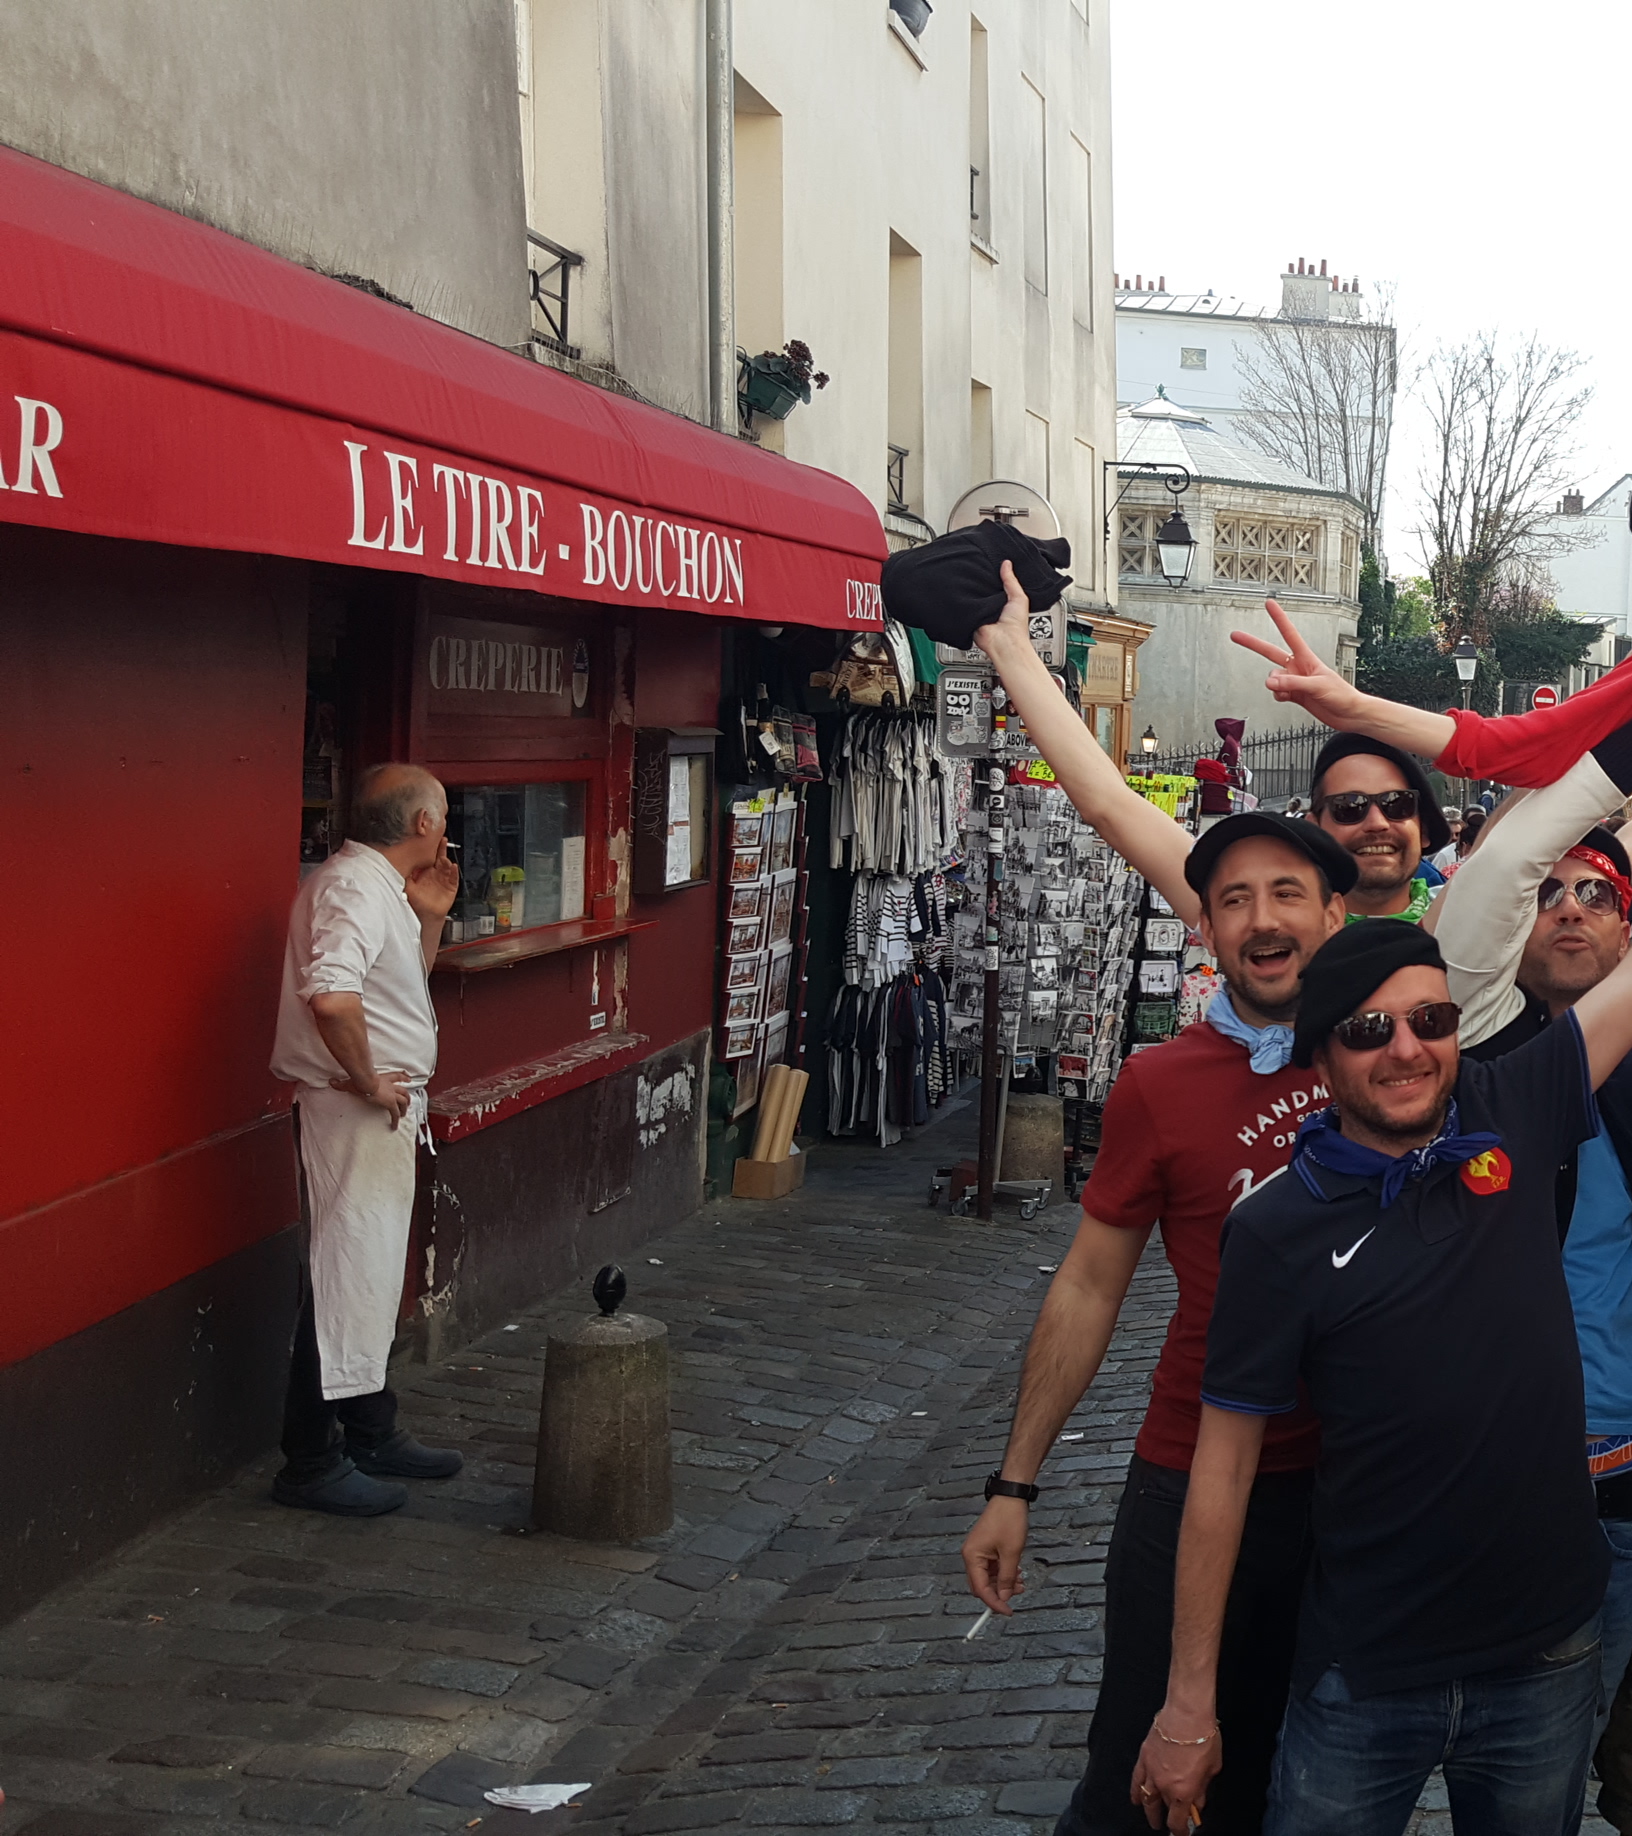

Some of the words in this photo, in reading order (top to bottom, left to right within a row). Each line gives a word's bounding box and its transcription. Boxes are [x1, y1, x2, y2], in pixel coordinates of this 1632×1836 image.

[0, 395, 64, 498] R
[343, 440, 424, 556] LE
[433, 463, 547, 576] TIRE
[579, 503, 745, 606] BOUCHON
[429, 636, 564, 697] CREPERIE
[1006, 733, 1026, 746] ABOV
[1237, 1082, 1330, 1147] HANDM
[1273, 1131, 1297, 1148] OR
